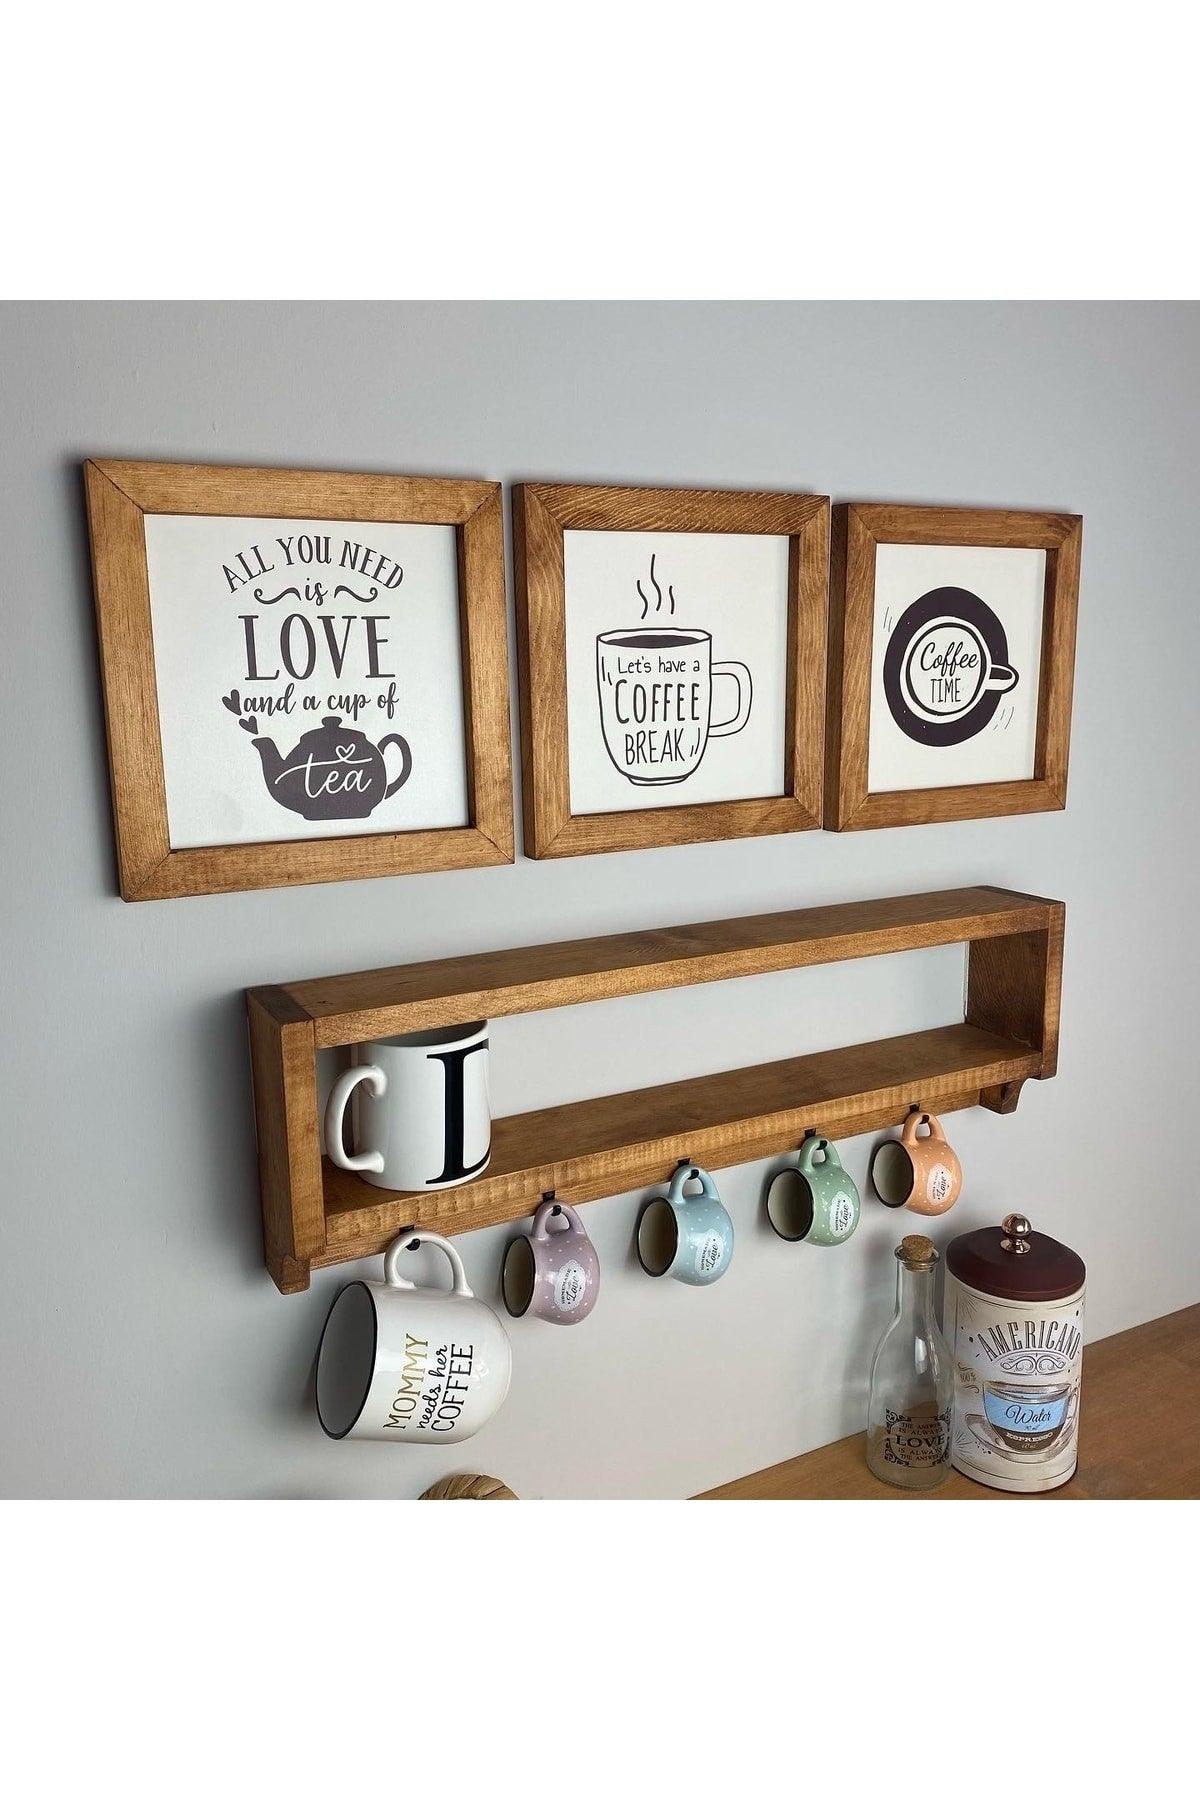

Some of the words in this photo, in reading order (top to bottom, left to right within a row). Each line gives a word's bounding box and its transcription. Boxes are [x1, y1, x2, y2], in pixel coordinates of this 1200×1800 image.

[222, 545, 275, 594] ALL
[276, 535, 332, 567] YOU
[339, 540, 405, 591] NEED
[304, 577, 328, 605] is
[238, 613, 396, 681] LOVE
[617, 655, 652, 674] Let's
[658, 656, 688, 674] have
[693, 661, 701, 672] a
[919, 642, 979, 679] Coffee
[243, 683, 297, 716] and
[303, 697, 321, 710] a
[327, 692, 371, 721] cup
[377, 682, 400, 719] of
[614, 678, 700, 724] COFFEE
[929, 678, 961, 705] TIME
[625, 729, 685, 766] BREAK
[275, 750, 373, 799] tea
[936, 1176, 947, 1198] Love
[839, 1204, 849, 1228] Love
[705, 1243, 718, 1268] Love
[566, 1275, 579, 1301] Love
[977, 1320, 1080, 1362] AMERICANO
[383, 1333, 429, 1430] MOMMY
[417, 1384, 441, 1429] needs
[429, 1344, 448, 1378] her
[431, 1344, 473, 1432] COFFEE
[1005, 1404, 1051, 1424] Water
[896, 1434, 945, 1447] LOVE
[1006, 1432, 1053, 1443] ESPRESSO
